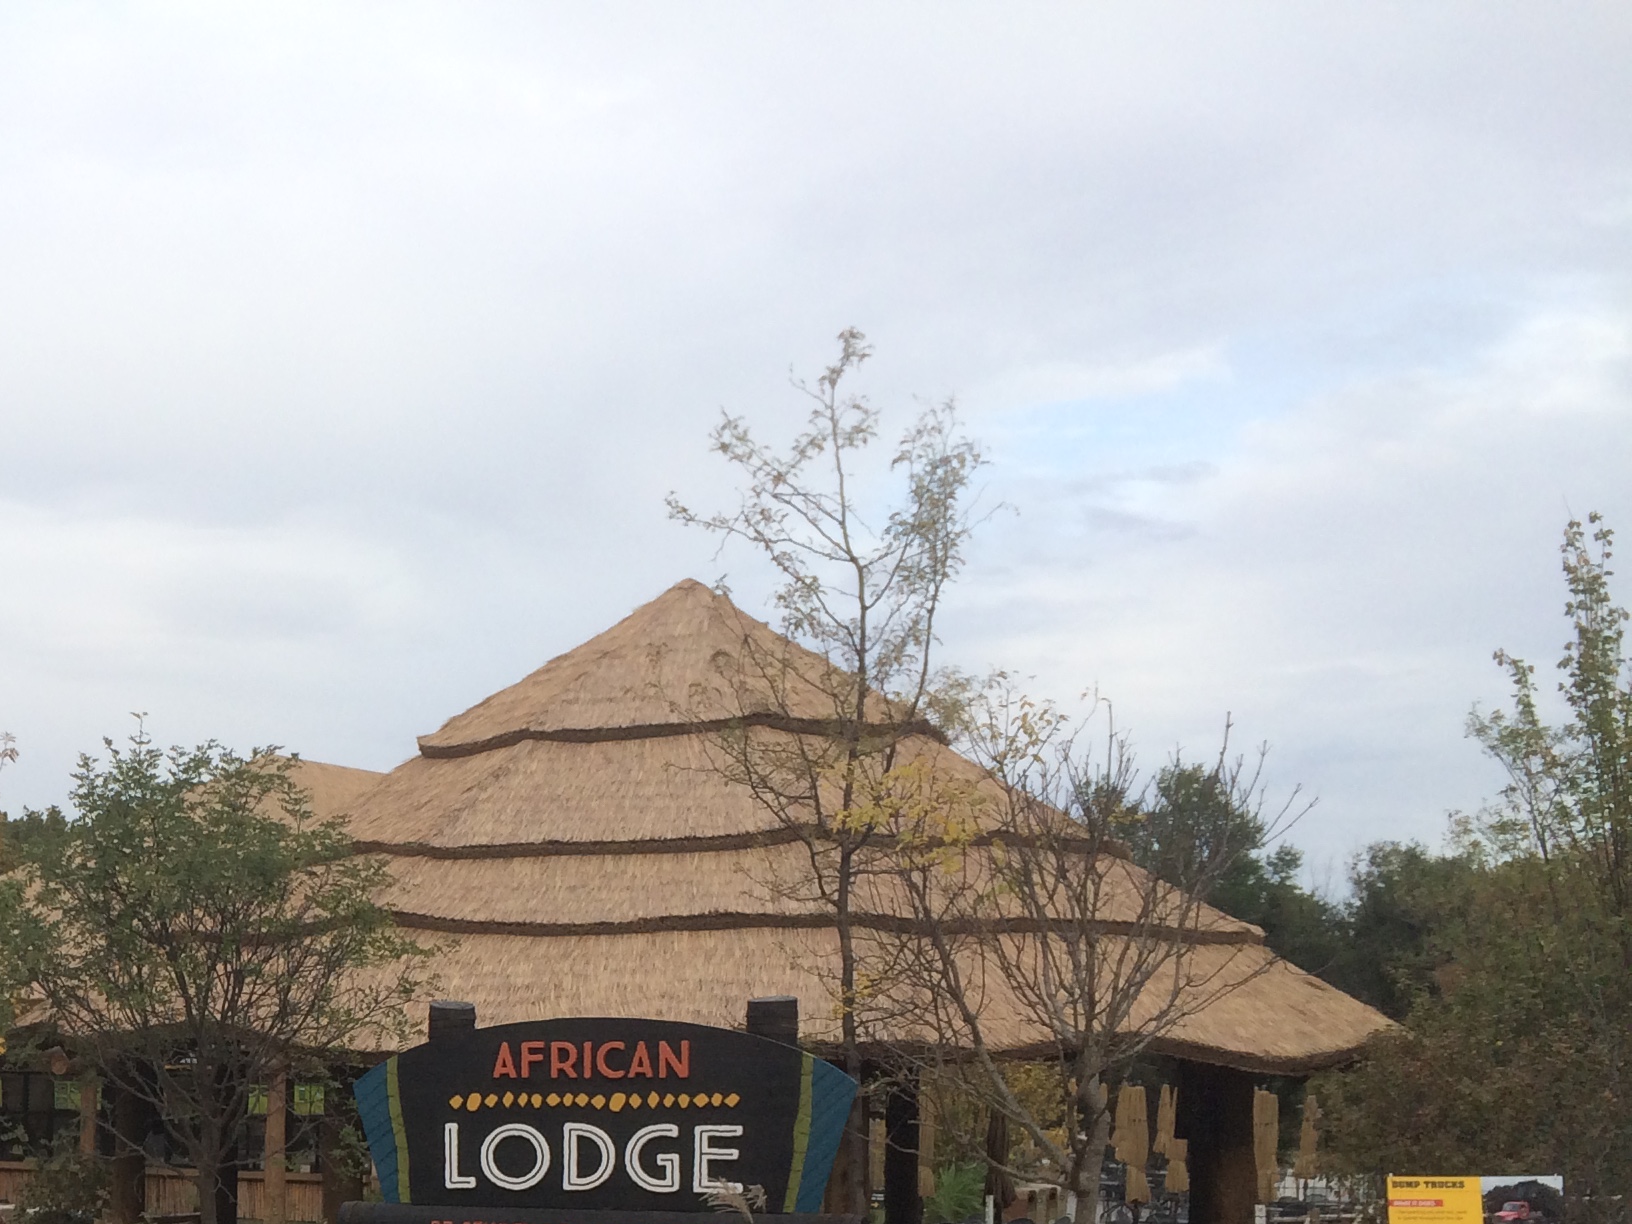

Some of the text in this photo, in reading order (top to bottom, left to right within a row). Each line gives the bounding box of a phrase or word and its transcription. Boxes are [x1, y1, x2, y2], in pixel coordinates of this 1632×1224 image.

[492, 1040, 690, 1079] AFRICAN
[444, 1122, 744, 1194] LODGE
[1392, 1181, 1465, 1189] DUMP TRUCKS
